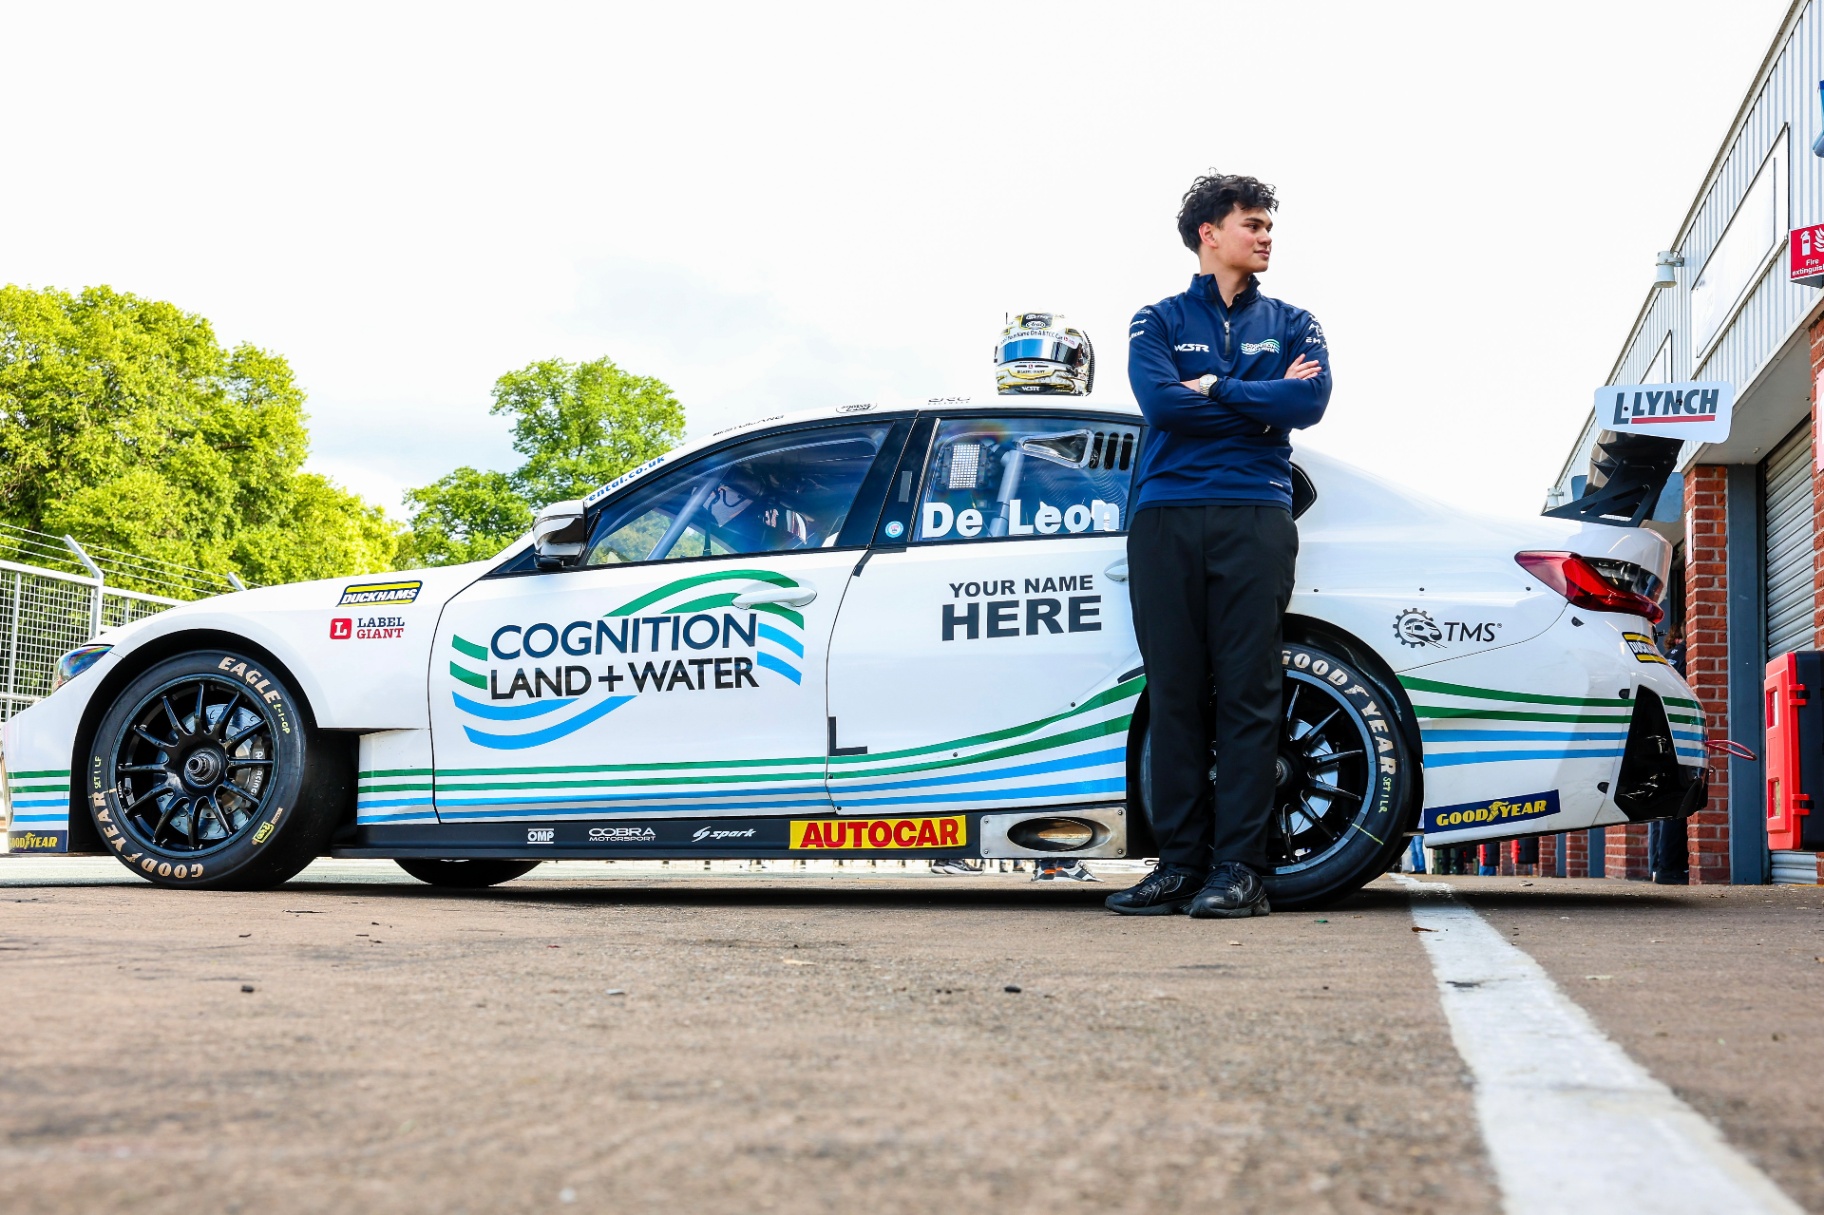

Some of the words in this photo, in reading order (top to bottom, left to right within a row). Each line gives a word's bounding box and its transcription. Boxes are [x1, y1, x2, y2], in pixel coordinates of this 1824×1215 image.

[922, 502, 984, 538] De
[1008, 499, 1120, 536] Leon
[949, 579, 1016, 598] YOUR
[1024, 575, 1094, 594] NAME
[340, 589, 418, 604] DUCKHAMS
[357, 617, 405, 628] LABEL
[942, 595, 1102, 642] HERE
[357, 628, 404, 639] GIANT
[490, 613, 757, 660] COGNITION
[218, 656, 281, 704] EAGLE
[527, 831, 554, 842] OMP
[588, 828, 656, 837] COBRA
[710, 828, 756, 839] spark
[800, 818, 958, 848] AUTOCAR
